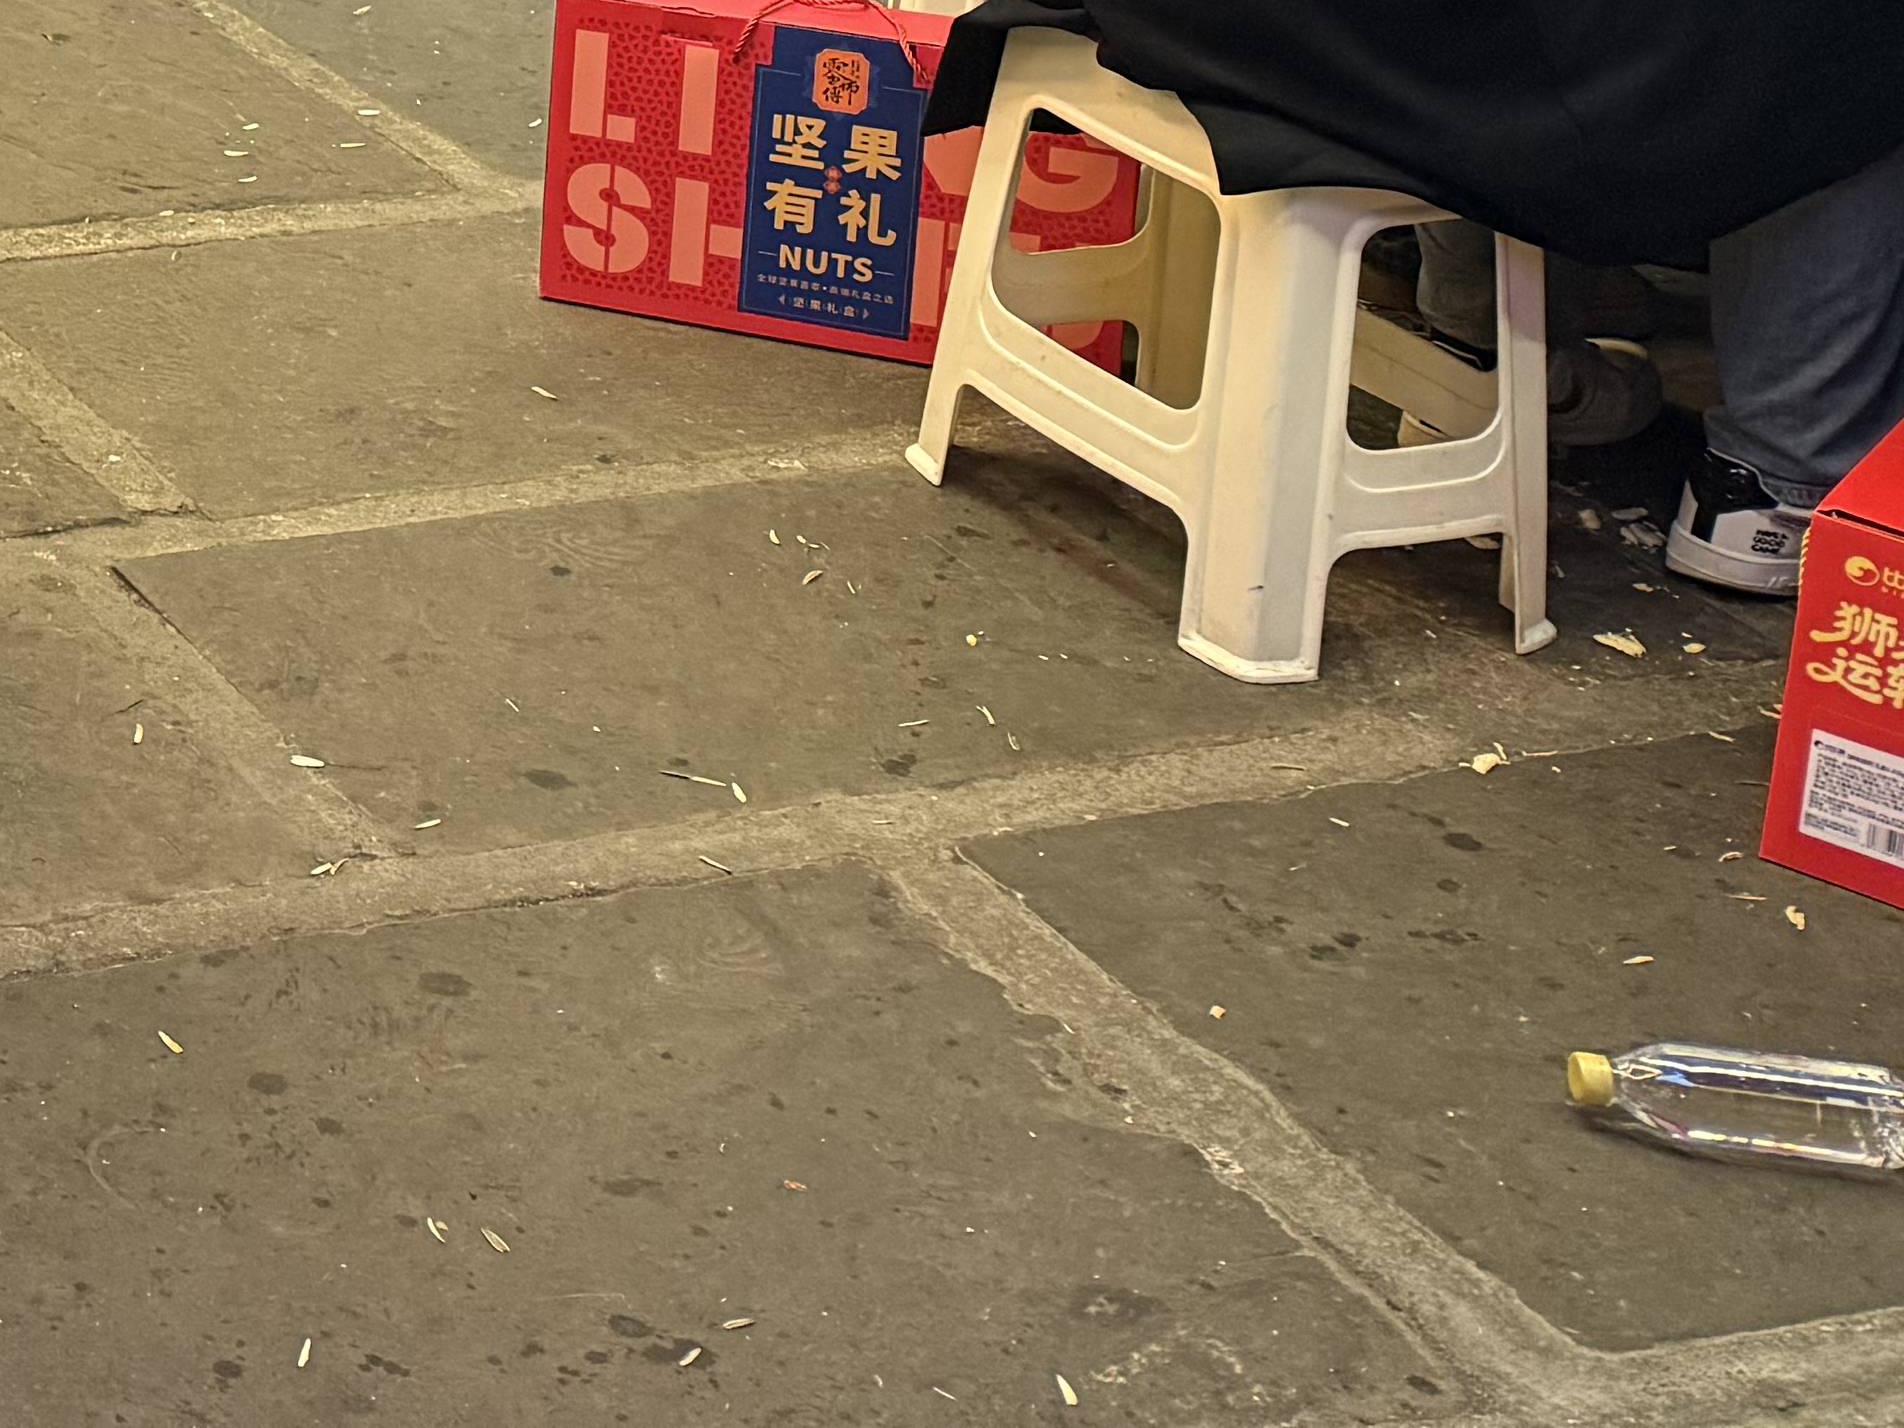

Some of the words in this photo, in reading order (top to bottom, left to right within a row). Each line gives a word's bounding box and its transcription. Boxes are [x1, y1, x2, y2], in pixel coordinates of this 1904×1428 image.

[769, 114, 902, 181] 坚果
[763, 179, 897, 246] 有礼
[778, 244, 874, 283] NUTS
[1810, 601, 1904, 659] 狮
